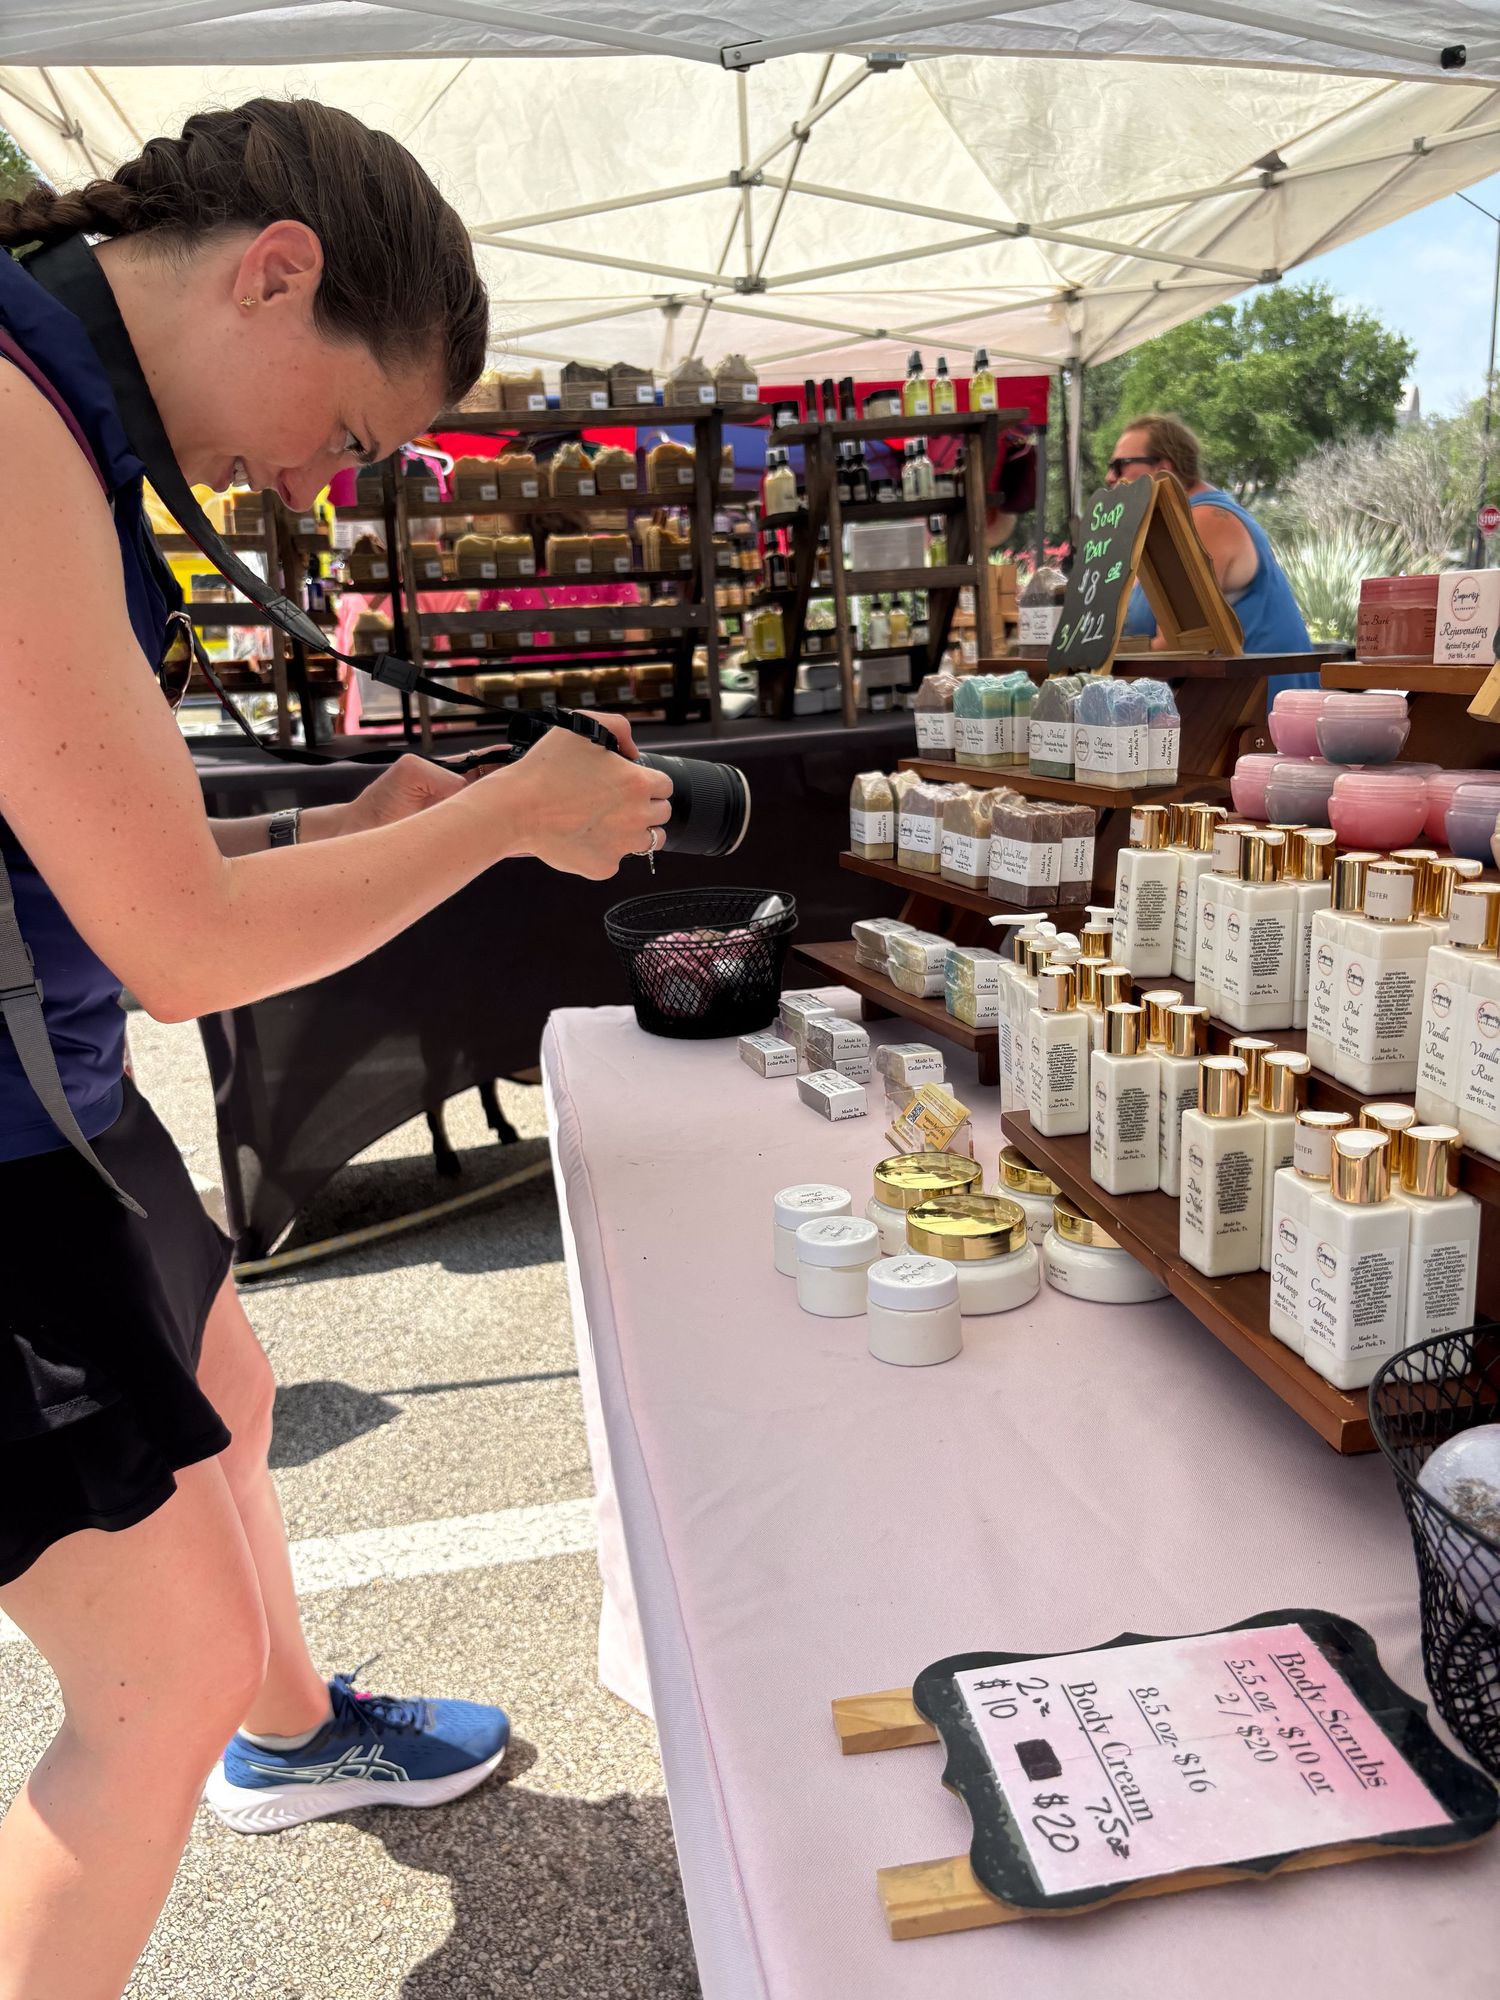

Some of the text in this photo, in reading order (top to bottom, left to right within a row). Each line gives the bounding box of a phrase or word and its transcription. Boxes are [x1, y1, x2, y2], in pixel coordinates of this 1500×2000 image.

[1091, 502, 1125, 531] Soap
[1084, 538, 1112, 564] Bar
[1371, 614, 1391, 625] Bark
[1440, 622, 1488, 640] Rejuvenating
[1463, 642, 1471, 651] Eye
[1472, 640, 1480, 650] Gel
[1315, 981, 1333, 996] Pink
[1314, 996, 1329, 1014] Sugar
[1344, 1001, 1363, 1016] Pink
[1342, 1017, 1358, 1035] Sugar
[1426, 1020, 1450, 1042] Vanilla
[1426, 1042, 1444, 1061] Rose
[1470, 1041, 1500, 1064] Vanilla
[1471, 1064, 1494, 1083] Rose
[1470, 1085, 1495, 1099] Body Cream
[1275, 1254, 1298, 1278] Coconut
[1272, 1272, 1298, 1299] Mango
[1311, 1278, 1336, 1304] Coconut
[1308, 1297, 1336, 1326] Mango
[1231, 1659, 1267, 1685] 5.5
[1254, 1692, 1277, 1711] oz
[1277, 1727, 1320, 1763] $10
[1308, 1772, 1334, 1792] or
[1276, 1651, 1387, 1787] Body Scrubs
[1136, 1687, 1170, 1715] 8.5
[1173, 1753, 1216, 1792] $16
[1236, 1725, 1278, 1762] $20
[1068, 1681, 1153, 1822] Body Cream
[1032, 1793, 1080, 1852] $20
